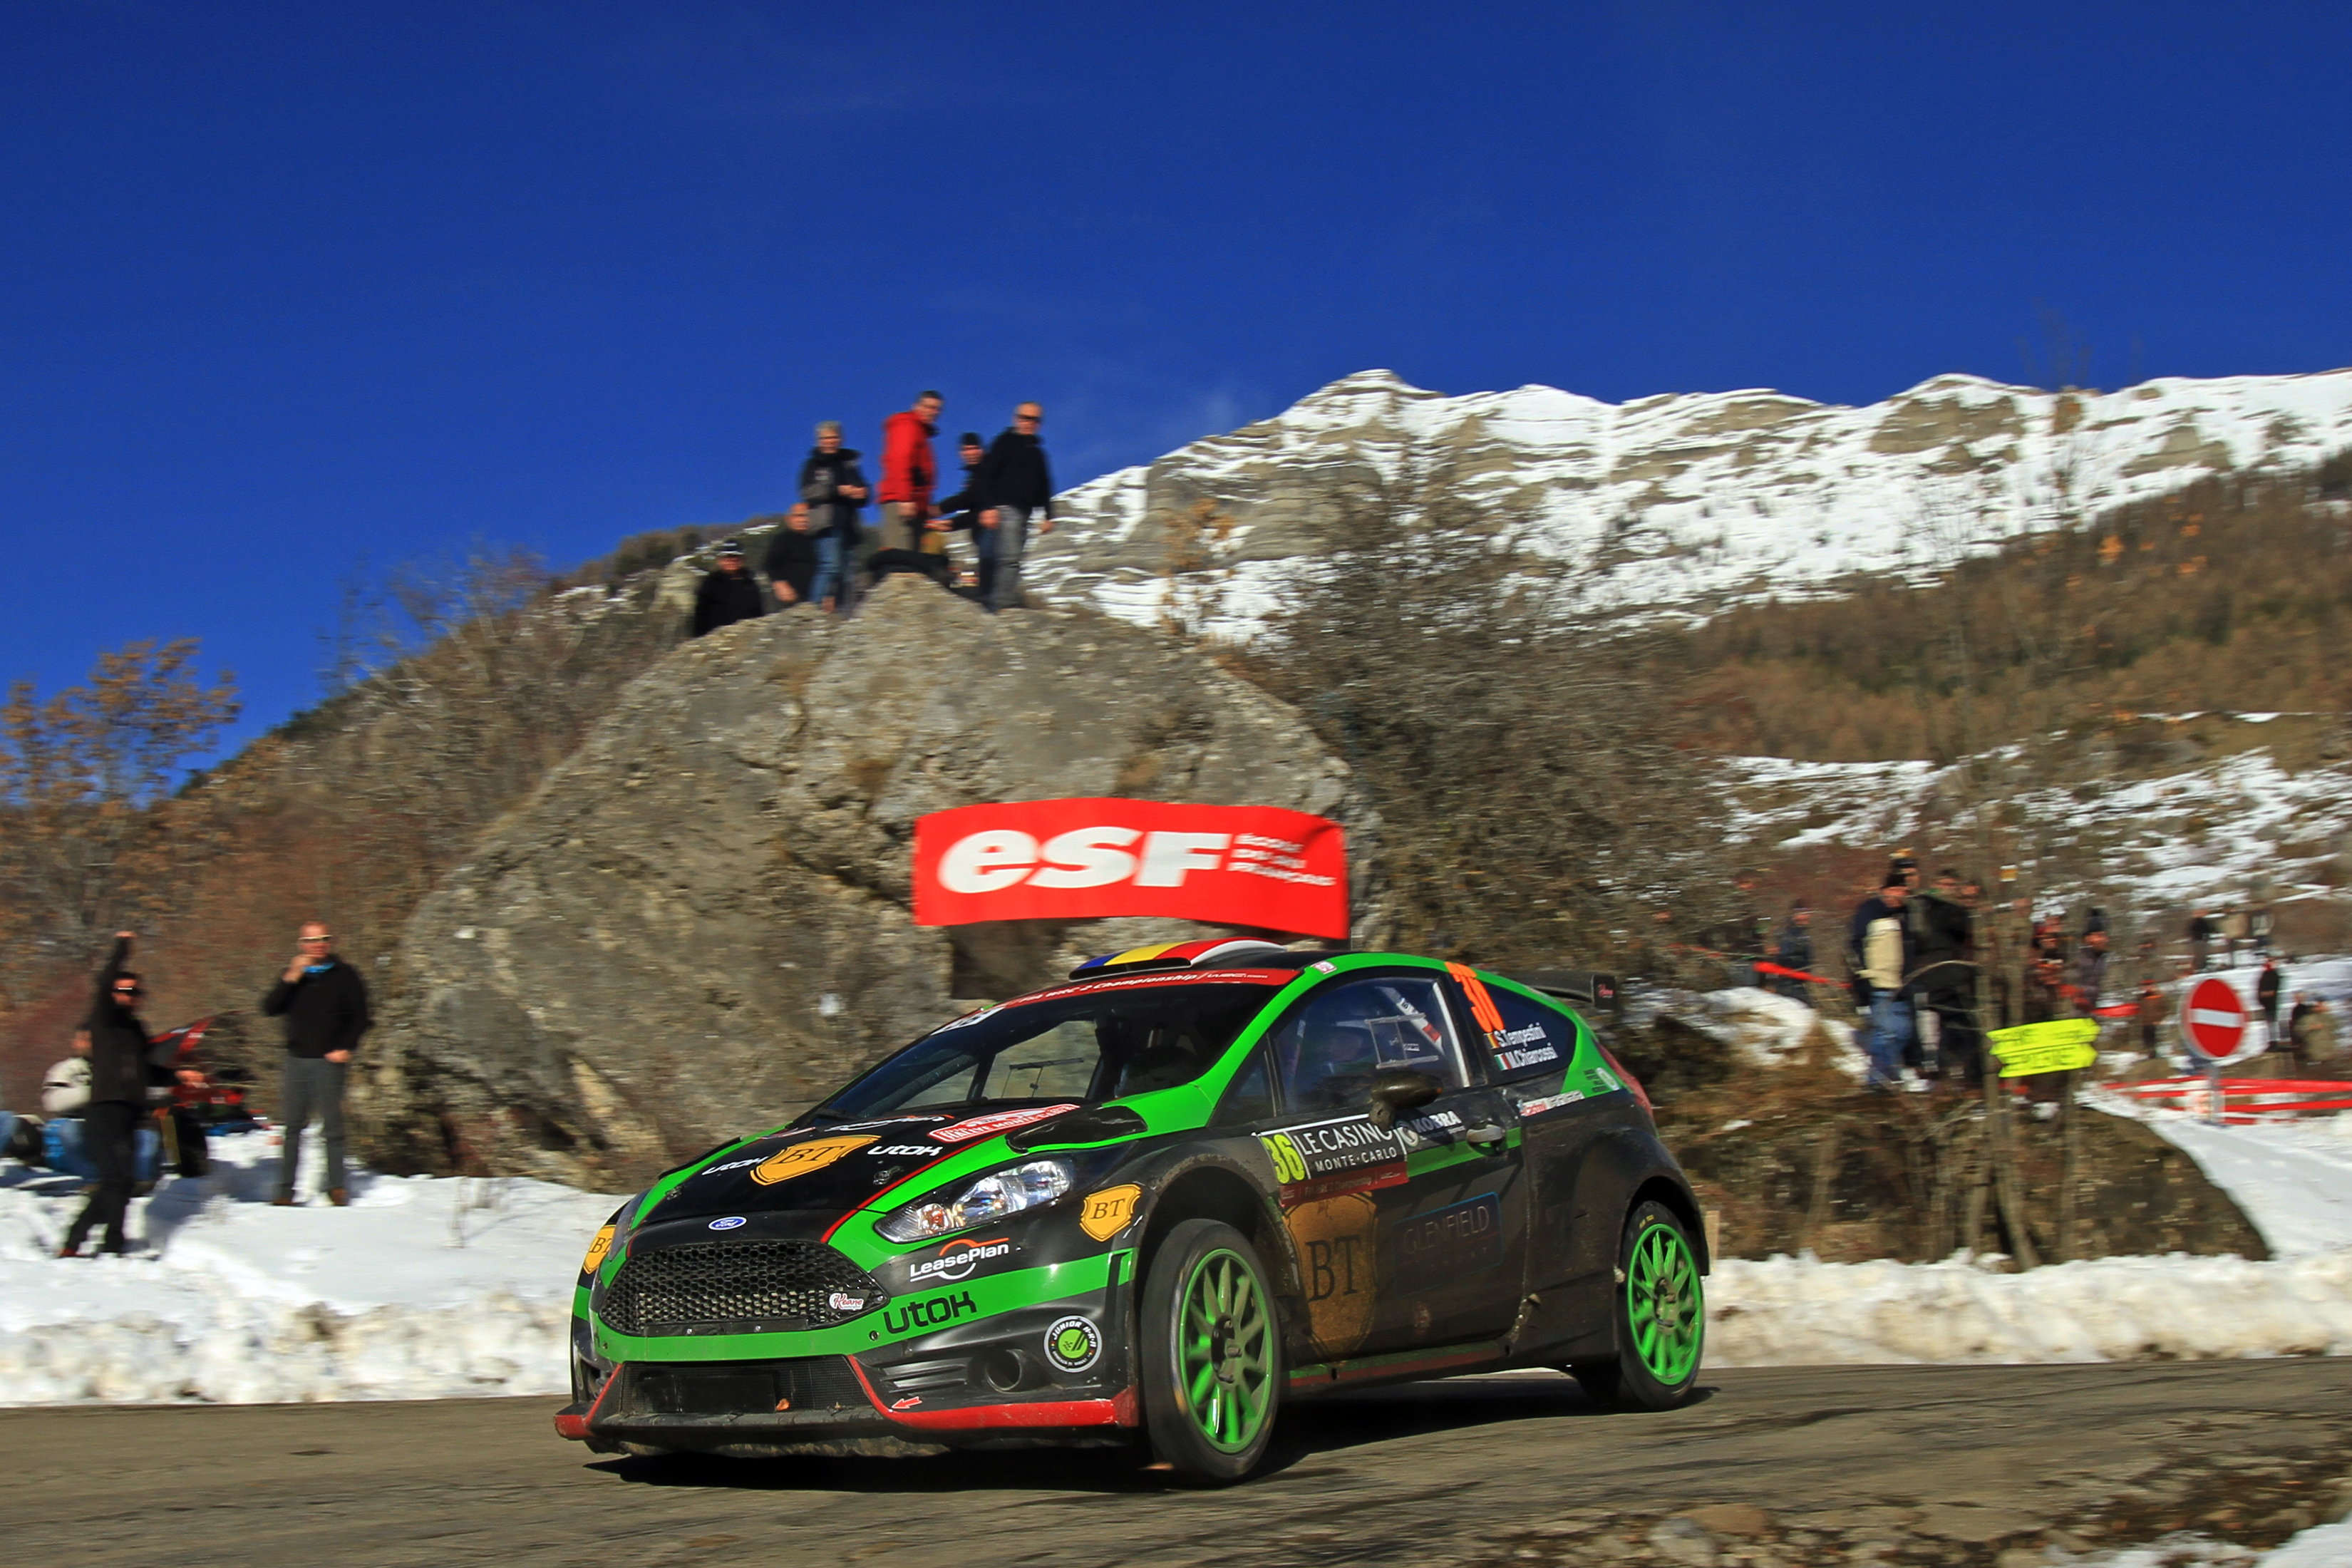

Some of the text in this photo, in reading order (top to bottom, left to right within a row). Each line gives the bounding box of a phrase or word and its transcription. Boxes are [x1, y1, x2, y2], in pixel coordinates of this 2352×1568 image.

[771, 1145, 847, 1165] BT
[1261, 1134, 1305, 1184] 36
[1089, 1197, 1126, 1219] BT
[910, 1243, 1010, 1277] LeasePlan
[1304, 1234, 1361, 1303] BT
[834, 1294, 862, 1309] Keane
[1052, 1321, 1082, 1341] JUNIOR
